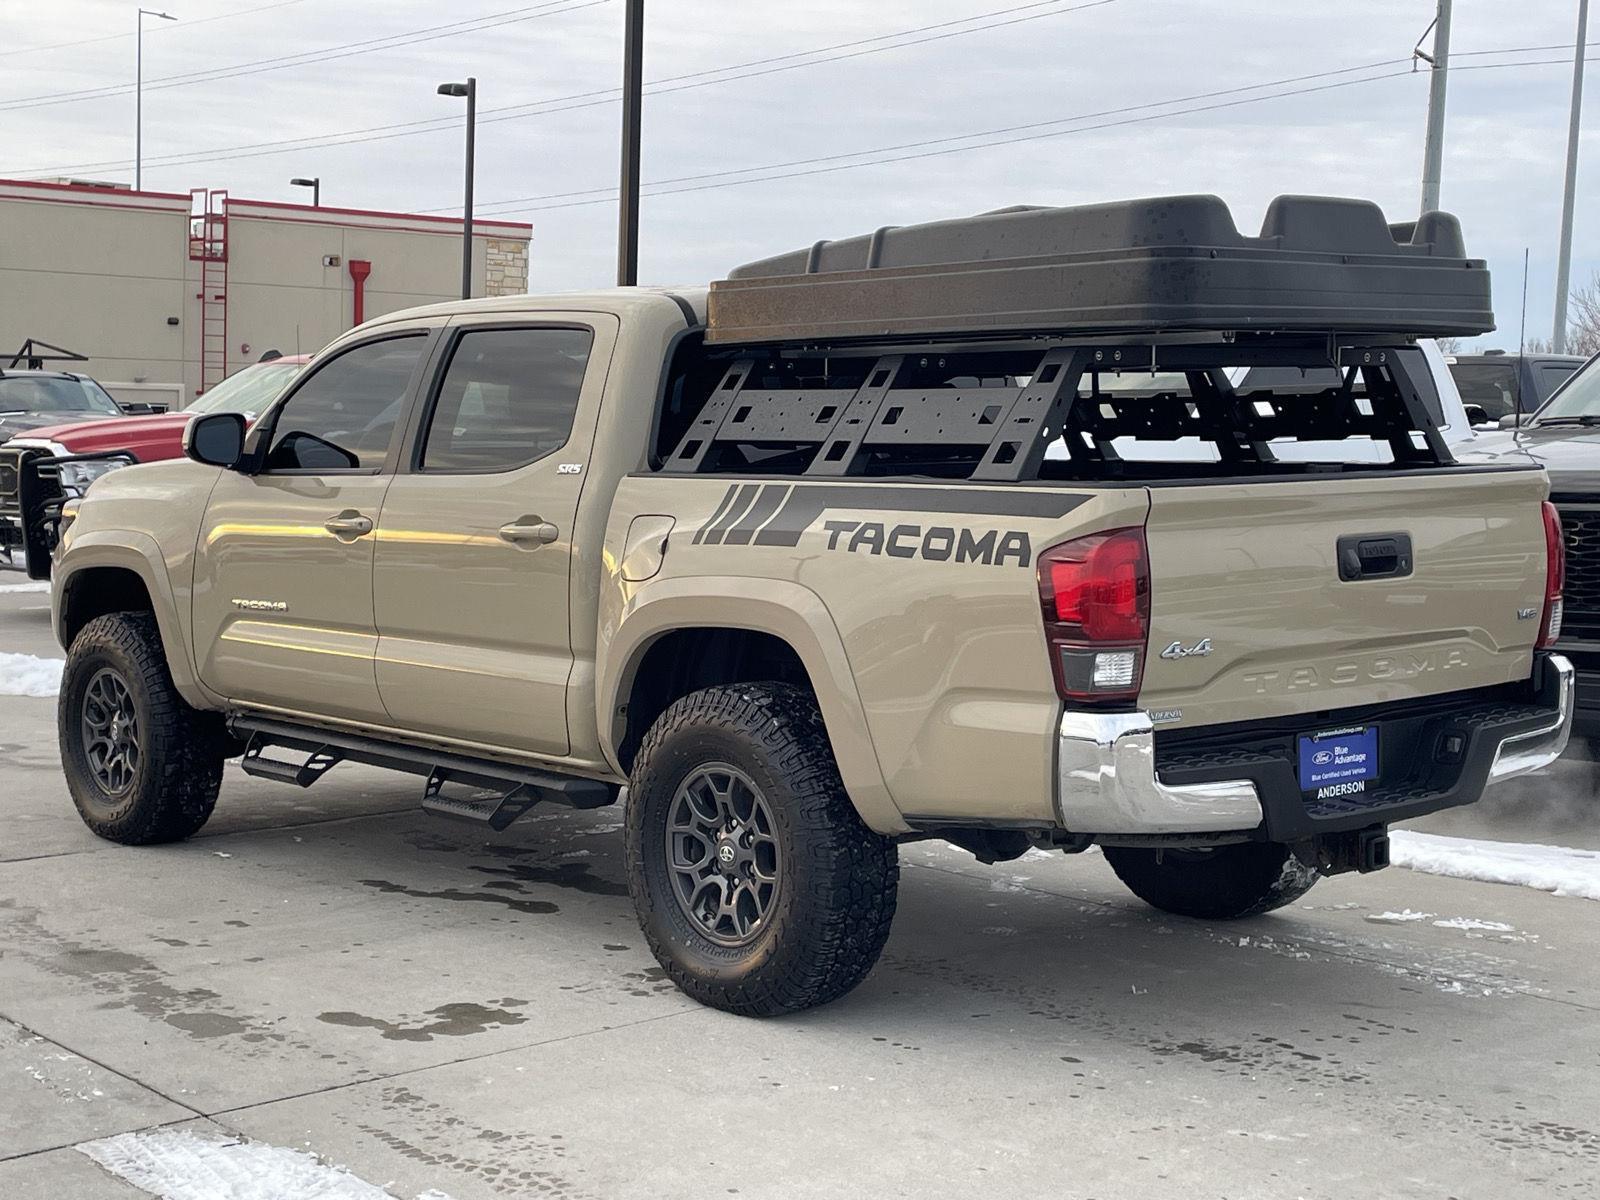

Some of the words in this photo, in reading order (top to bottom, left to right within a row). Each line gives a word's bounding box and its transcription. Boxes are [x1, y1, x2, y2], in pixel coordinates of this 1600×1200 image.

[557, 463, 583, 475] SR5
[824, 520, 1032, 568] TACOMA
[231, 598, 289, 612] TACOMA
[1160, 638, 1214, 660] 4x4
[1243, 650, 1469, 694] TACOMA
[1334, 746, 1349, 755] Blue
[1334, 753, 1366, 764] Advantage
[1321, 771, 1340, 779] Certified
[1352, 767, 1366, 775] Vehicle
[1317, 780, 1365, 800] ANDERSON
